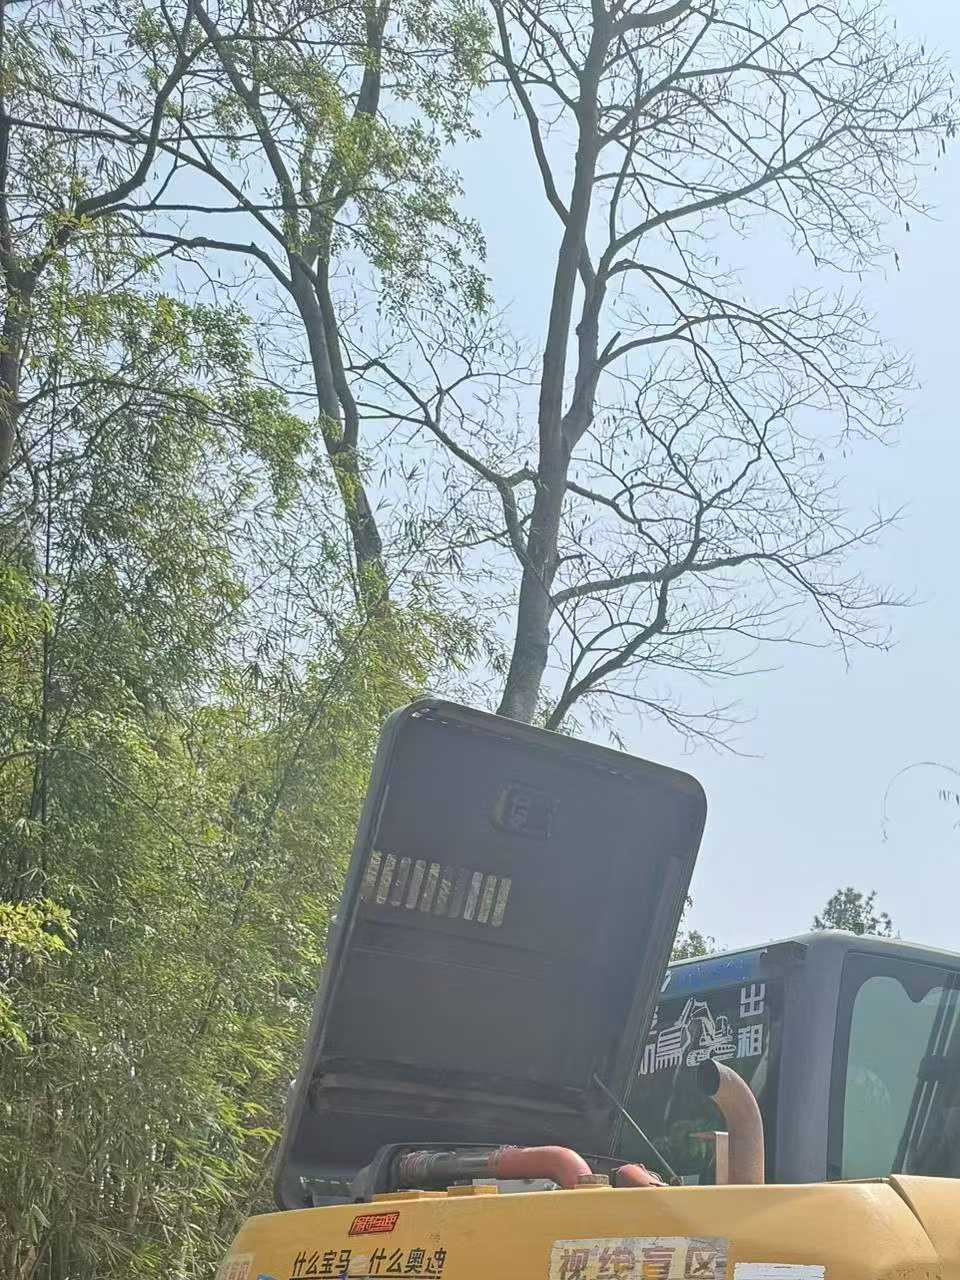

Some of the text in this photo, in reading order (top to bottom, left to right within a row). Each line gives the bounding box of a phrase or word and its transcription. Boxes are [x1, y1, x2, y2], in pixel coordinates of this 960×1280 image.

[737, 983, 766, 1058] 出租
[291, 1250, 351, 1277] 什么宝马
